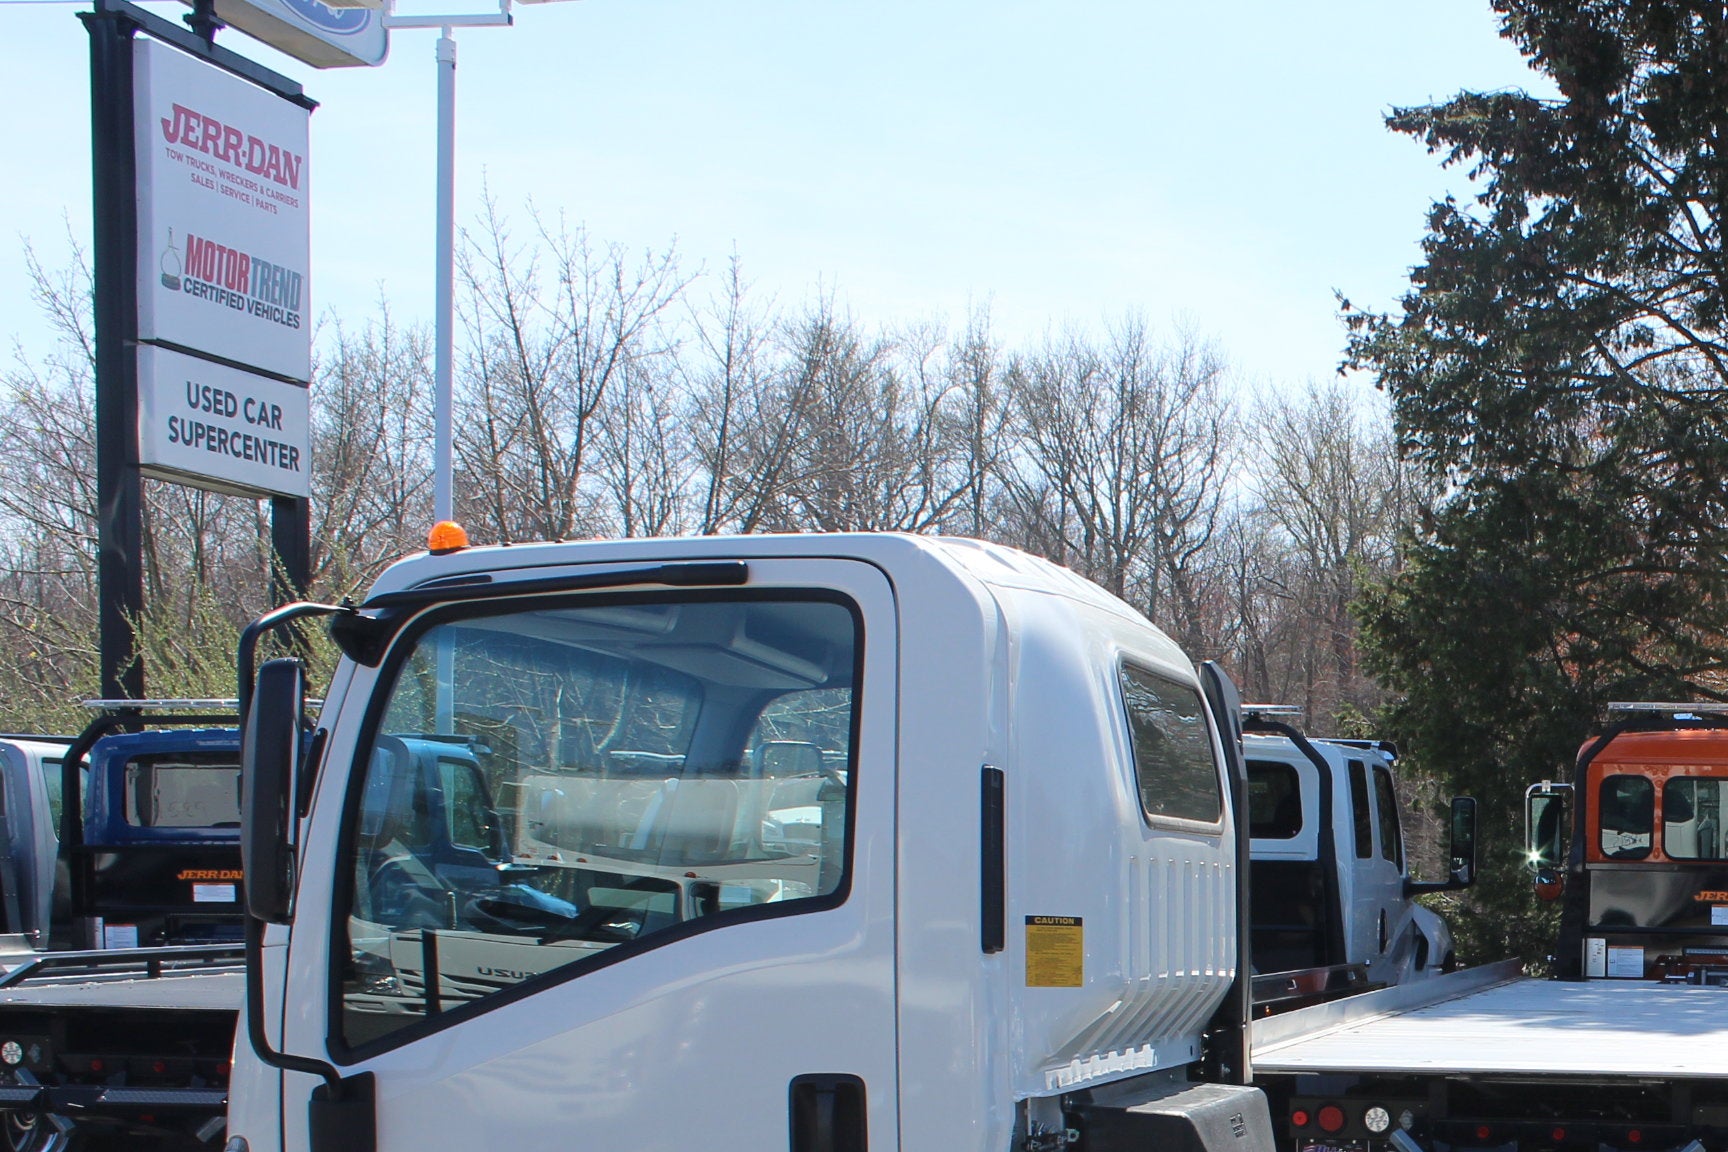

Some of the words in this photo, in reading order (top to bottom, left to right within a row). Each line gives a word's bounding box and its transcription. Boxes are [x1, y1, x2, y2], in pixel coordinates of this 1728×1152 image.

[165, 147, 184, 162] TOW
[185, 155, 217, 177] TRUCKS,
[218, 168, 259, 193] WRECKERS
[260, 185, 265, 196] &
[266, 188, 299, 209] CARRIERS
[190, 173, 215, 190] SALES
[220, 185, 250, 205] SERVICE
[255, 197, 278, 215] PARTS
[183, 277, 245, 311] CERTIFIED
[246, 300, 301, 330] VEHICLES
[186, 381, 238, 418] USED
[243, 397, 283, 431] CAR
[168, 415, 300, 472] SUPERCENTER
[1034, 916, 1075, 925] CAUTION
